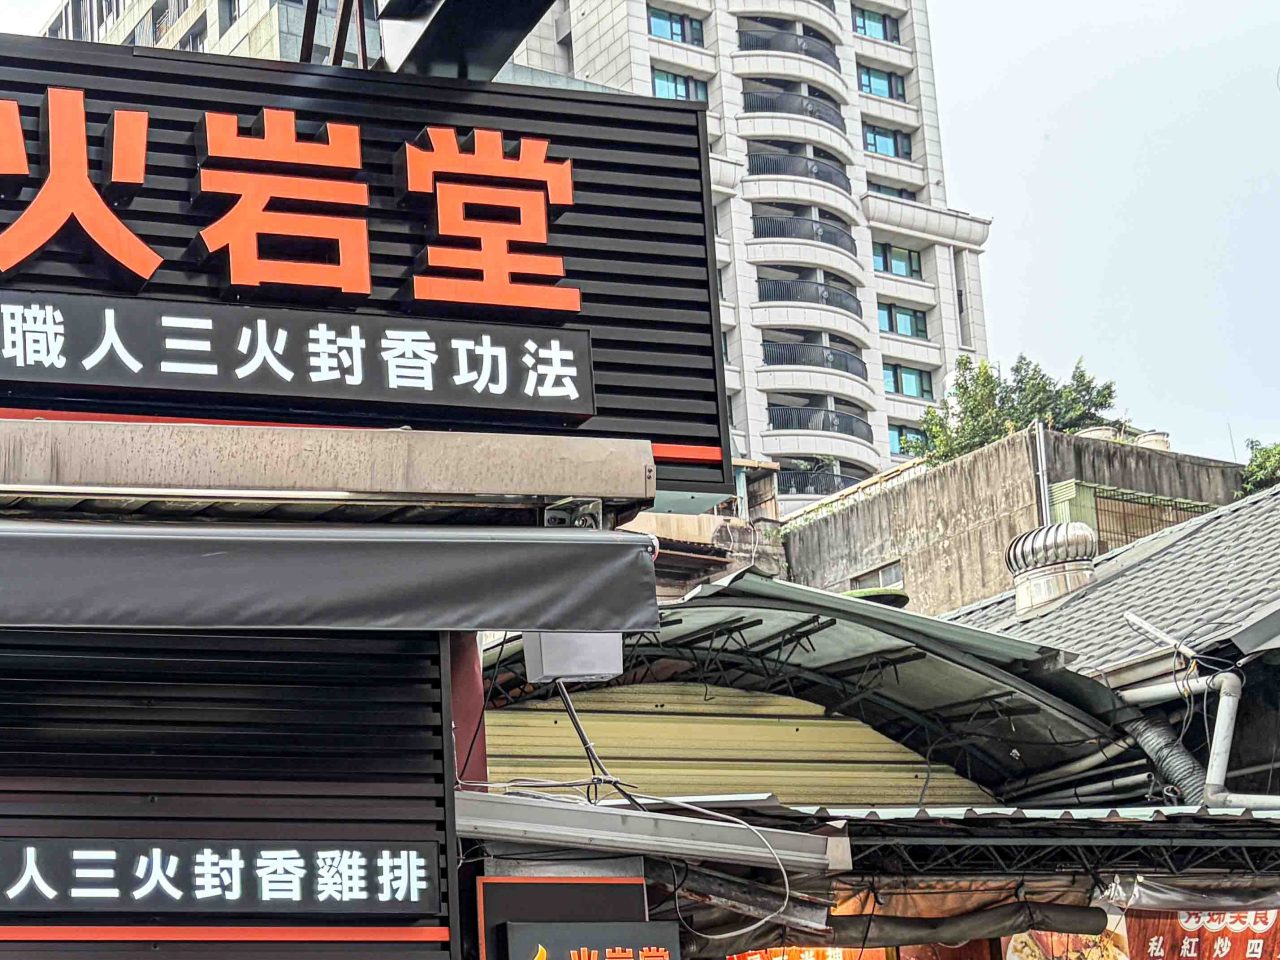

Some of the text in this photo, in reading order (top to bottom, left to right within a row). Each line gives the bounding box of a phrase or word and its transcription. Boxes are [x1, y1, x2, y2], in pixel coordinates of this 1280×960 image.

[0, 302, 581, 402] 職人三火封香功法
